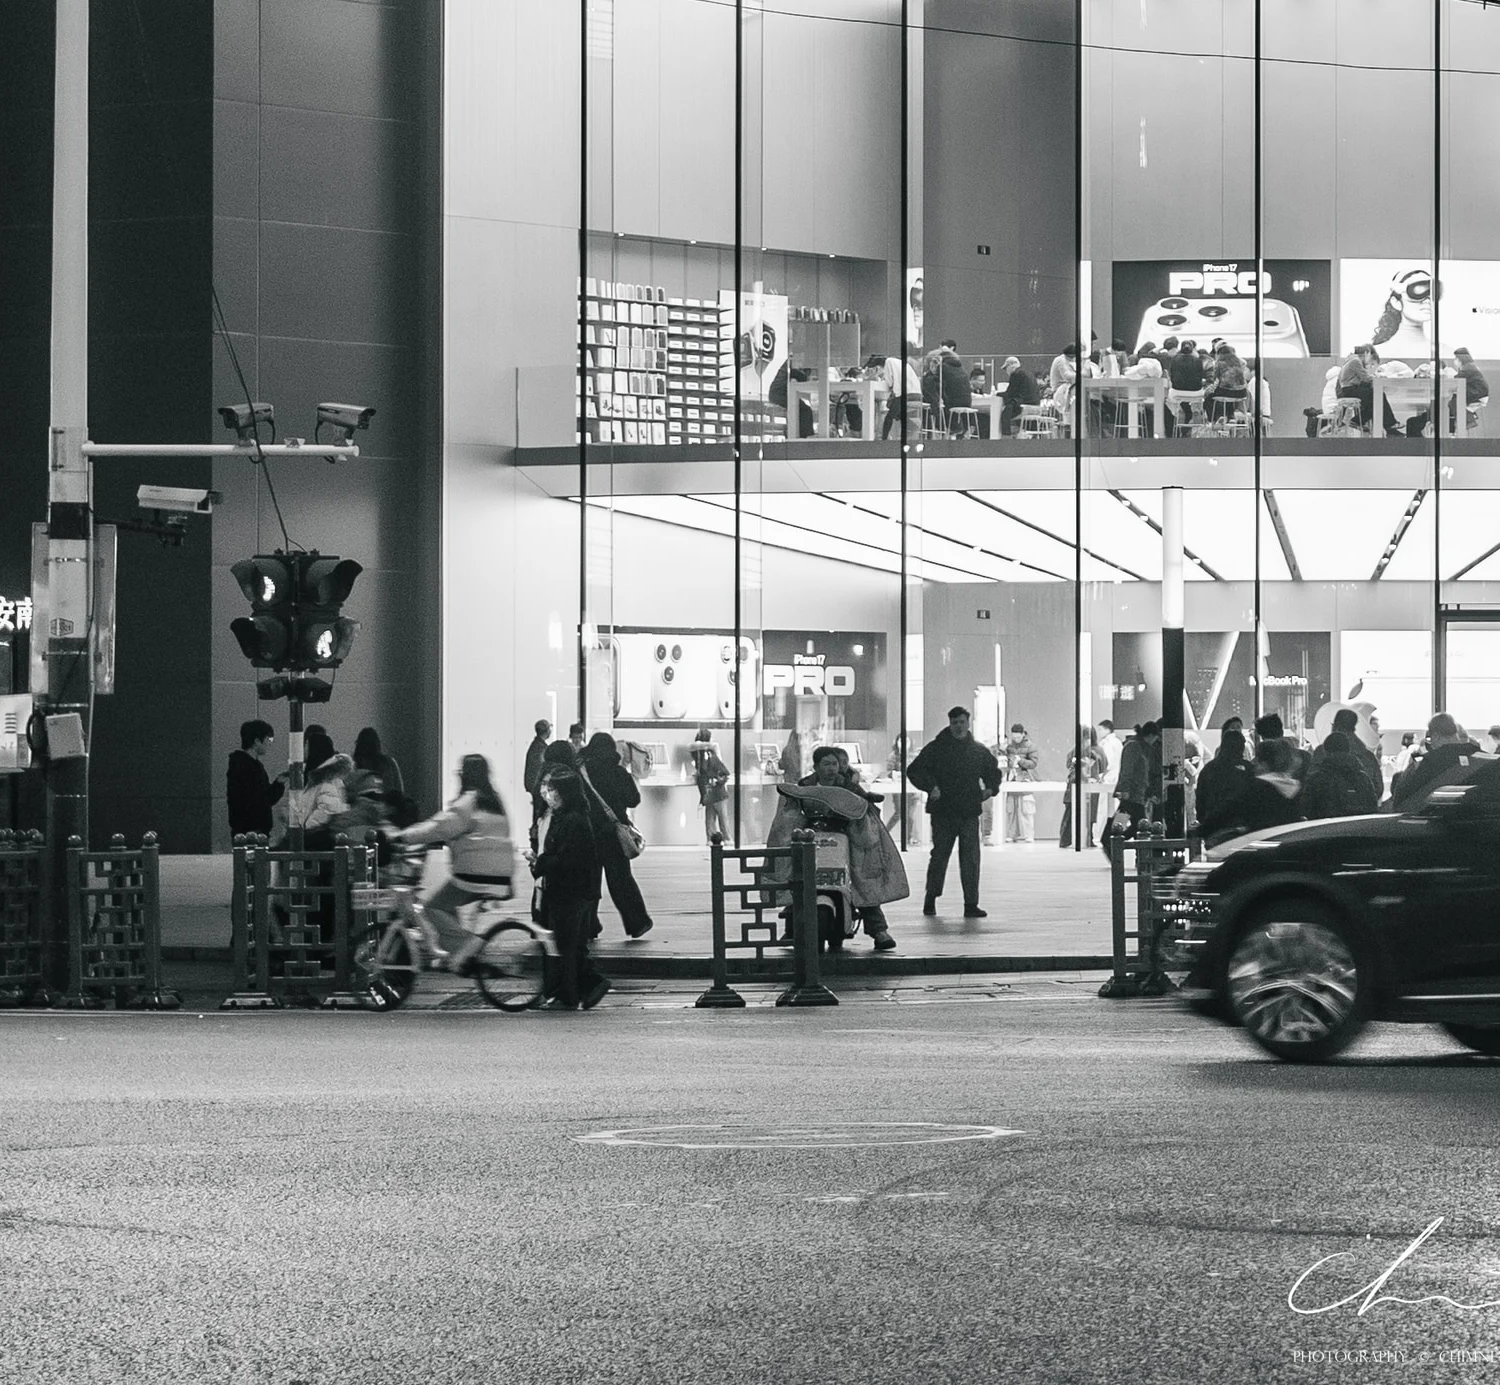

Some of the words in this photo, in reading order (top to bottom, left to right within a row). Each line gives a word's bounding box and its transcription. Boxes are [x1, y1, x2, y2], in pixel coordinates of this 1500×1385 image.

[1169, 272, 1272, 295] PRO
[763, 665, 856, 696] PRO
[1292, 676, 1308, 686] Pro
